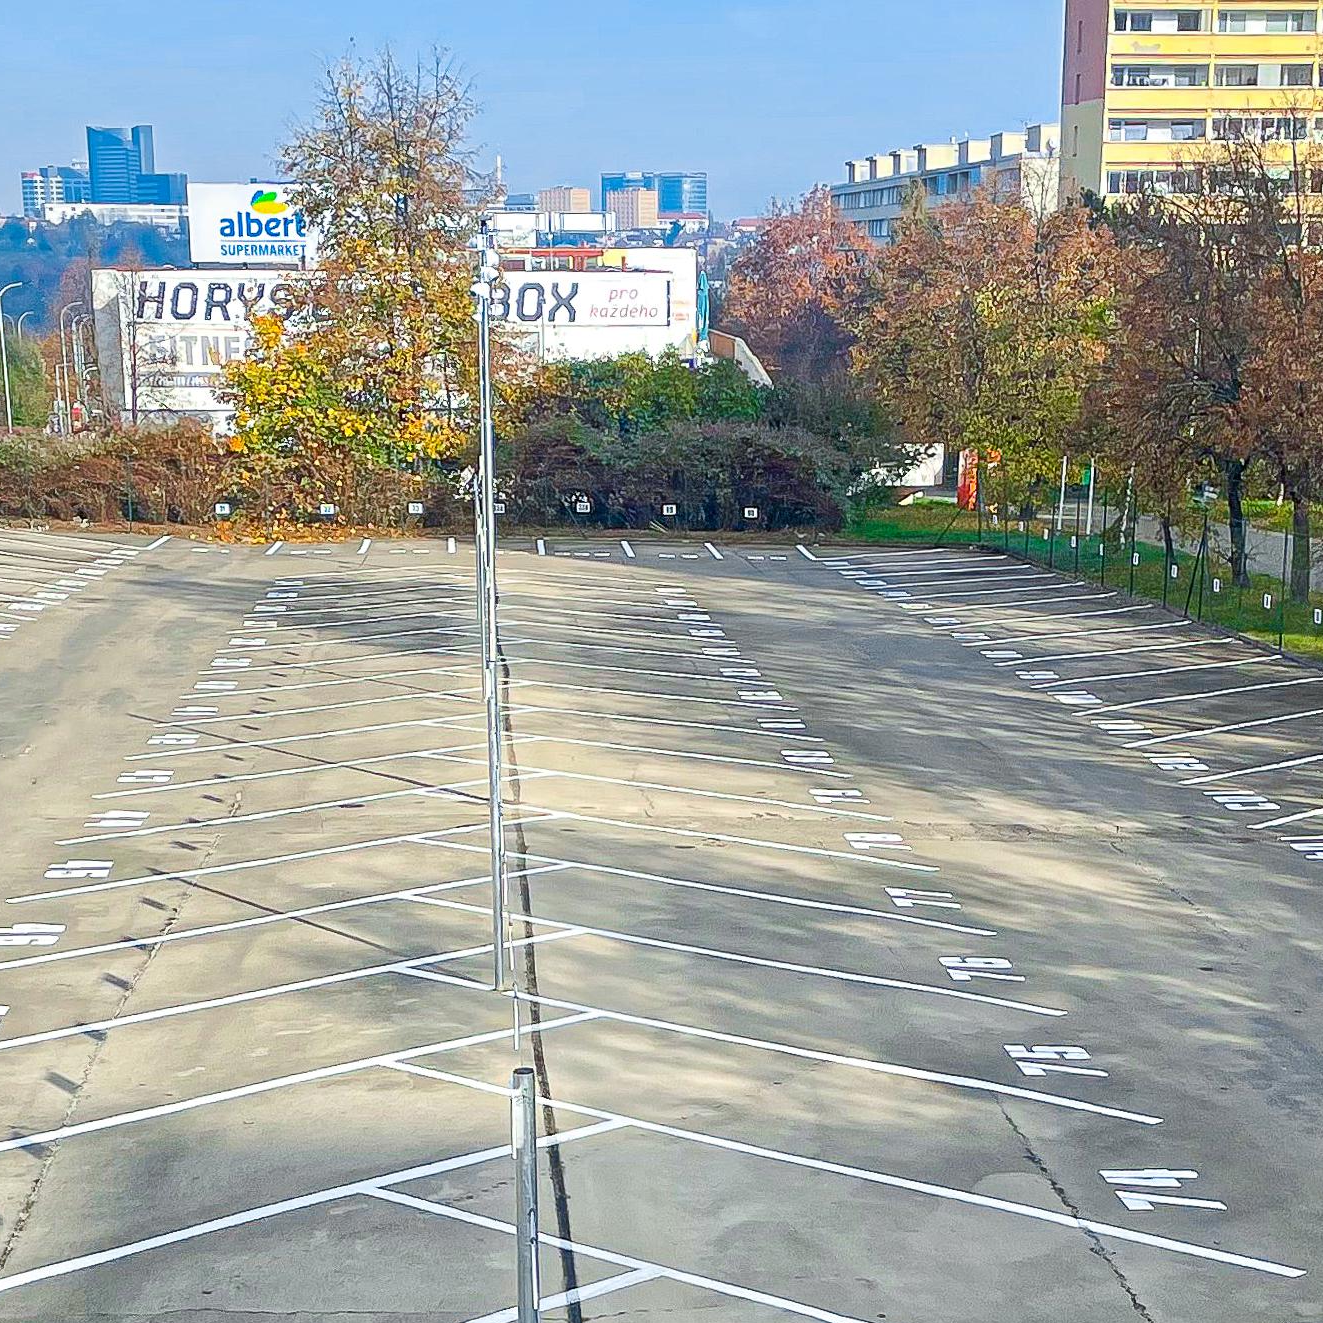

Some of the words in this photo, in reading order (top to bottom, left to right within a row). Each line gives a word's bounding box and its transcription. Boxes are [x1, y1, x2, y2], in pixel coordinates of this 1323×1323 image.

[220, 211, 307, 237] albert
[221, 244, 306, 256] SUPERMARKET
[608, 286, 639, 303] pro
[589, 304, 659, 318] každého
[45, 861, 113, 878] 45
[885, 888, 961, 908] 77
[939, 957, 1025, 981] 76
[1004, 1045, 1108, 1076] 75
[1100, 1169, 1227, 1210] 74
